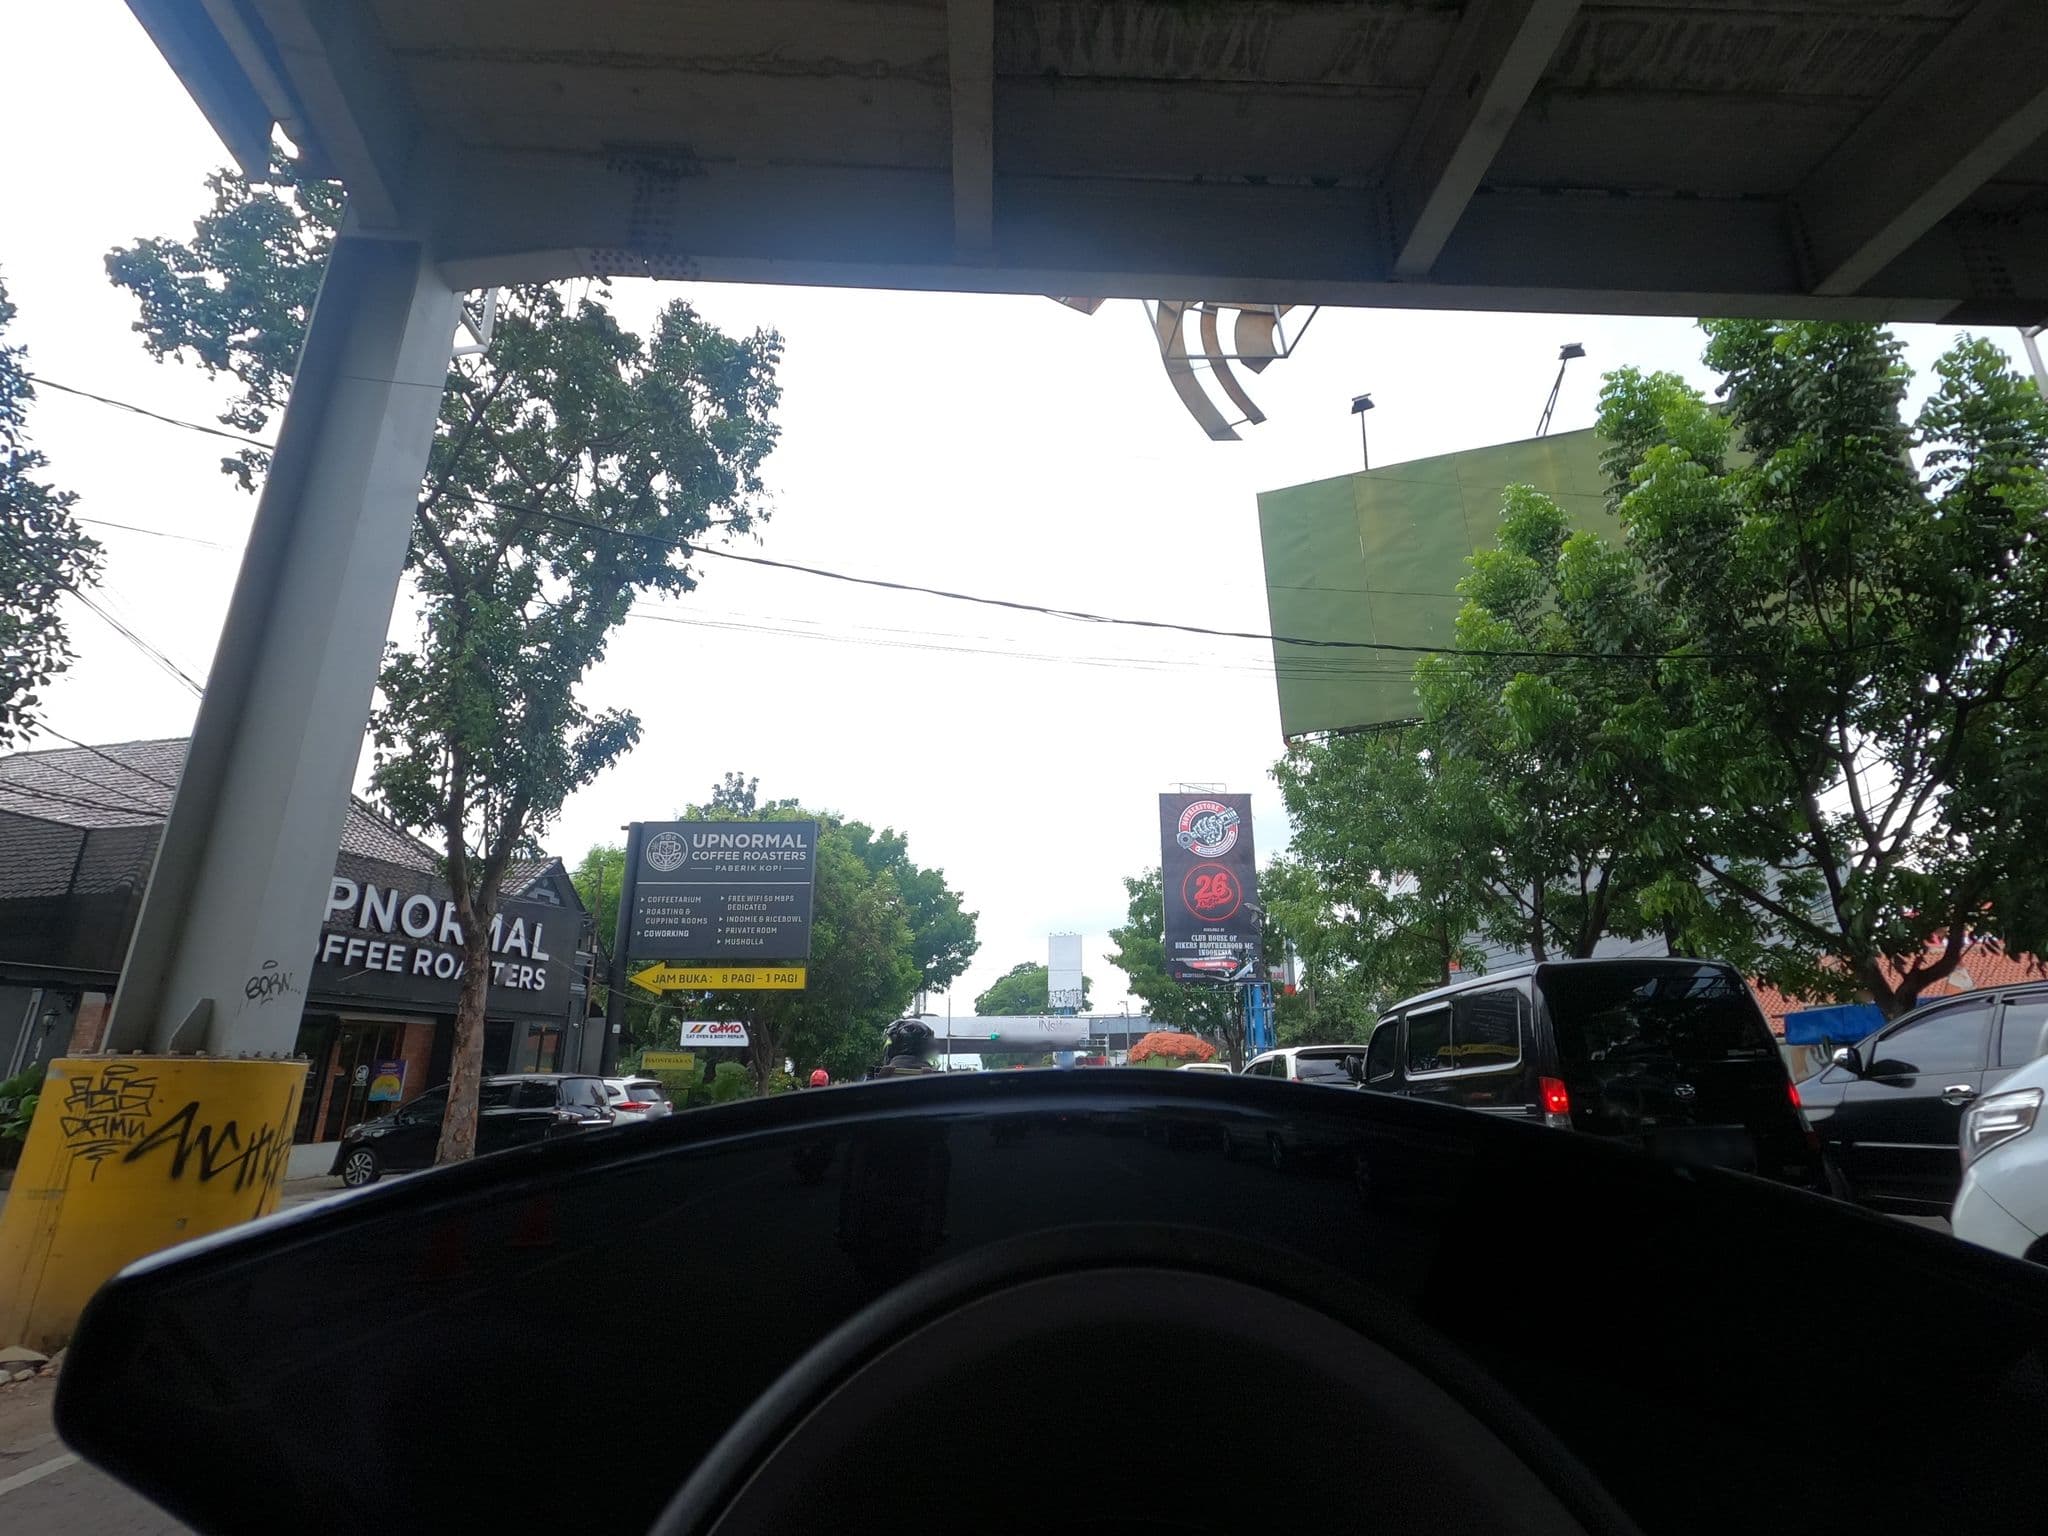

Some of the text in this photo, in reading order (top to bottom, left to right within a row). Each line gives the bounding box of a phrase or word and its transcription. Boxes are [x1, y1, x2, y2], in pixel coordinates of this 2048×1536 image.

[693, 833, 807, 849] UPNORMAL
[692, 851, 807, 861] COFFEE ROASTERS
[1194, 872, 1234, 904] 26
[647, 896, 702, 904] COFFEETARIUM
[323, 877, 550, 961] PNORAL
[645, 917, 708, 925] CUPPING ROOMS
[314, 934, 547, 991] FFEE ROTERS
[652, 974, 676, 984] JAM
[679, 974, 713, 983] BUKA:
[721, 974, 728, 983] 8
[731, 974, 755, 983] PAGI
[774, 973, 798, 983] PAGI
